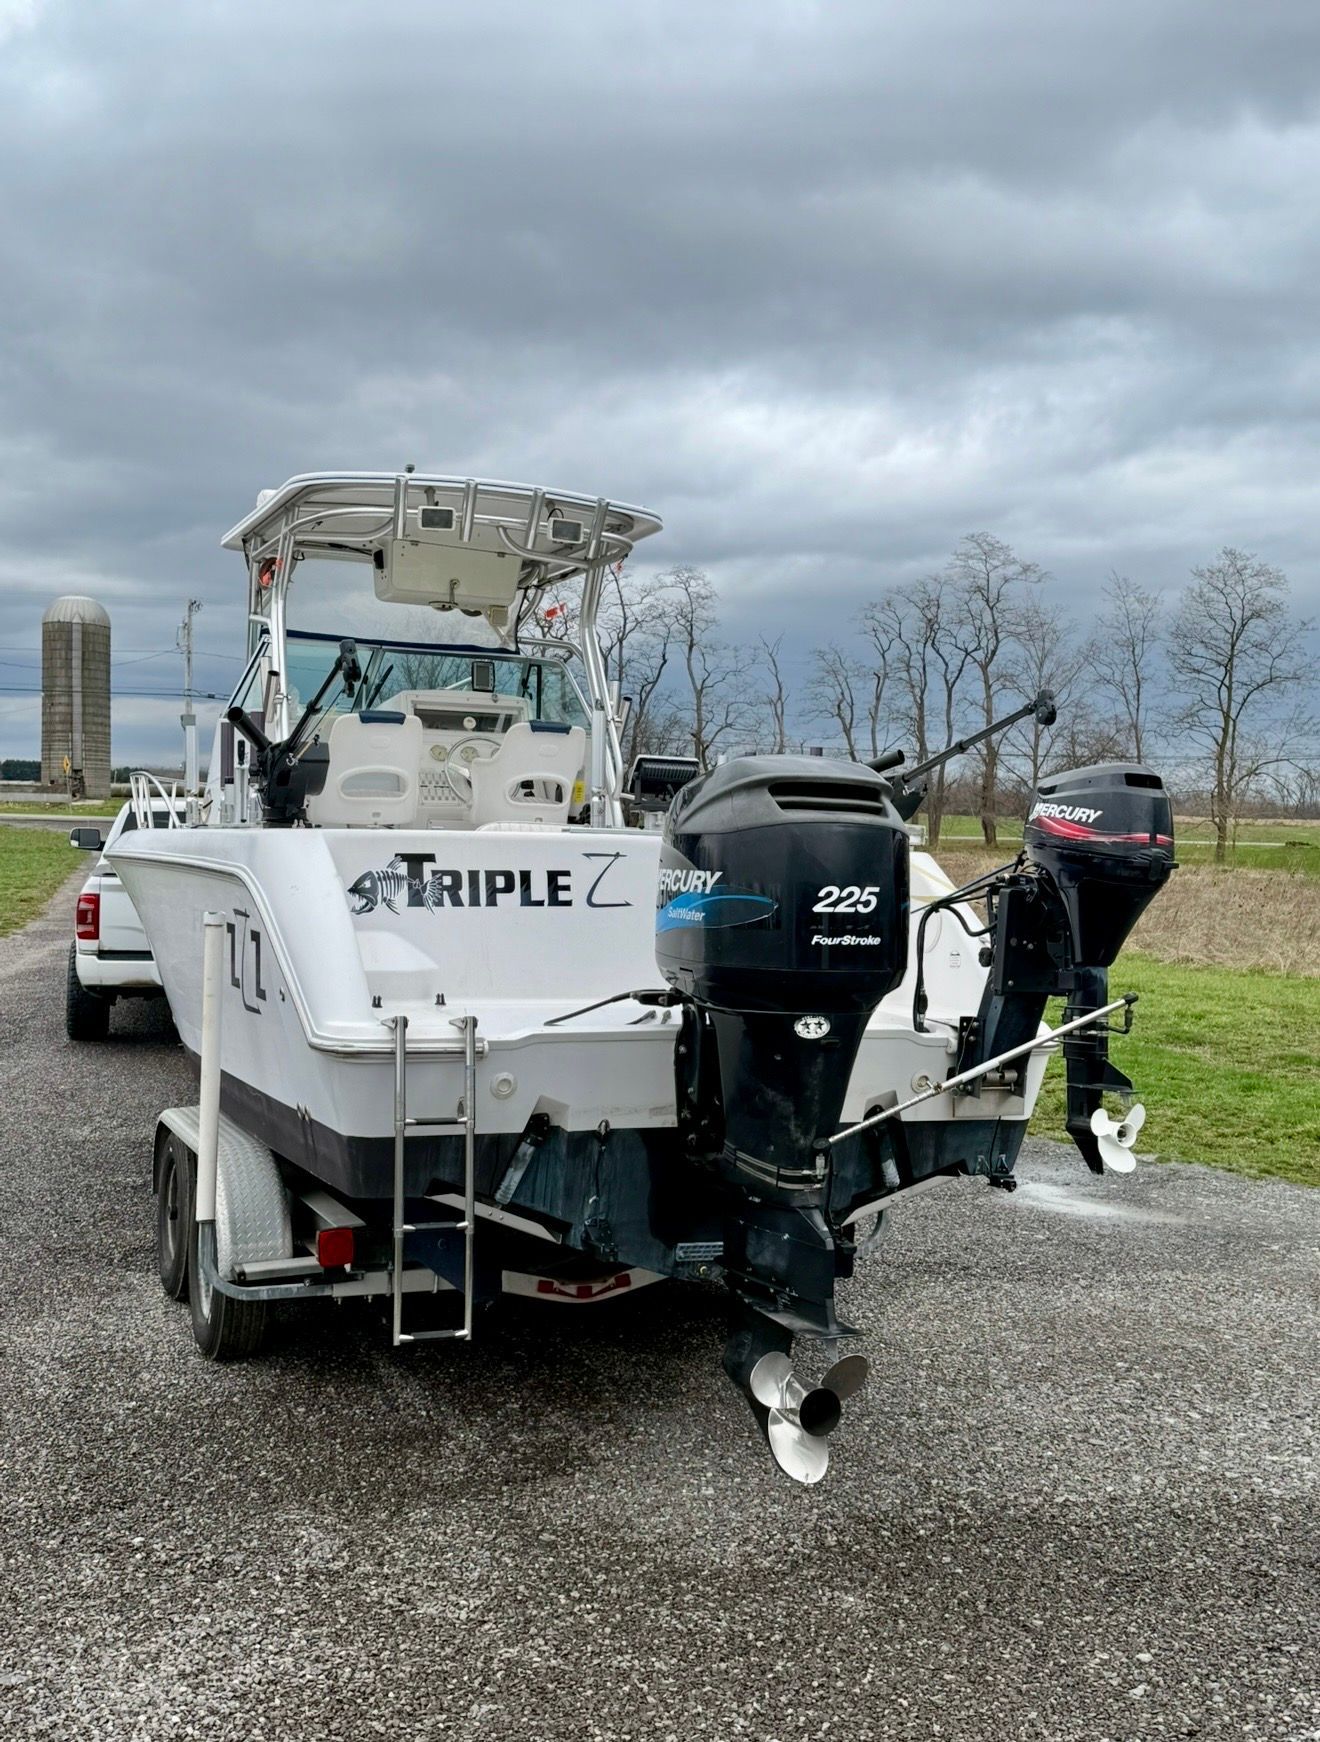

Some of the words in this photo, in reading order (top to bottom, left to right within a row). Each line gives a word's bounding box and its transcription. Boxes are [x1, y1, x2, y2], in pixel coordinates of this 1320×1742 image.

[1028, 802, 1104, 823] MERCURY
[395, 853, 573, 907] TRIPLE
[657, 868, 723, 894] ERCURY
[811, 885, 880, 914] 225
[667, 906, 706, 921] SaltWater
[811, 935, 881, 945] FourStroke
